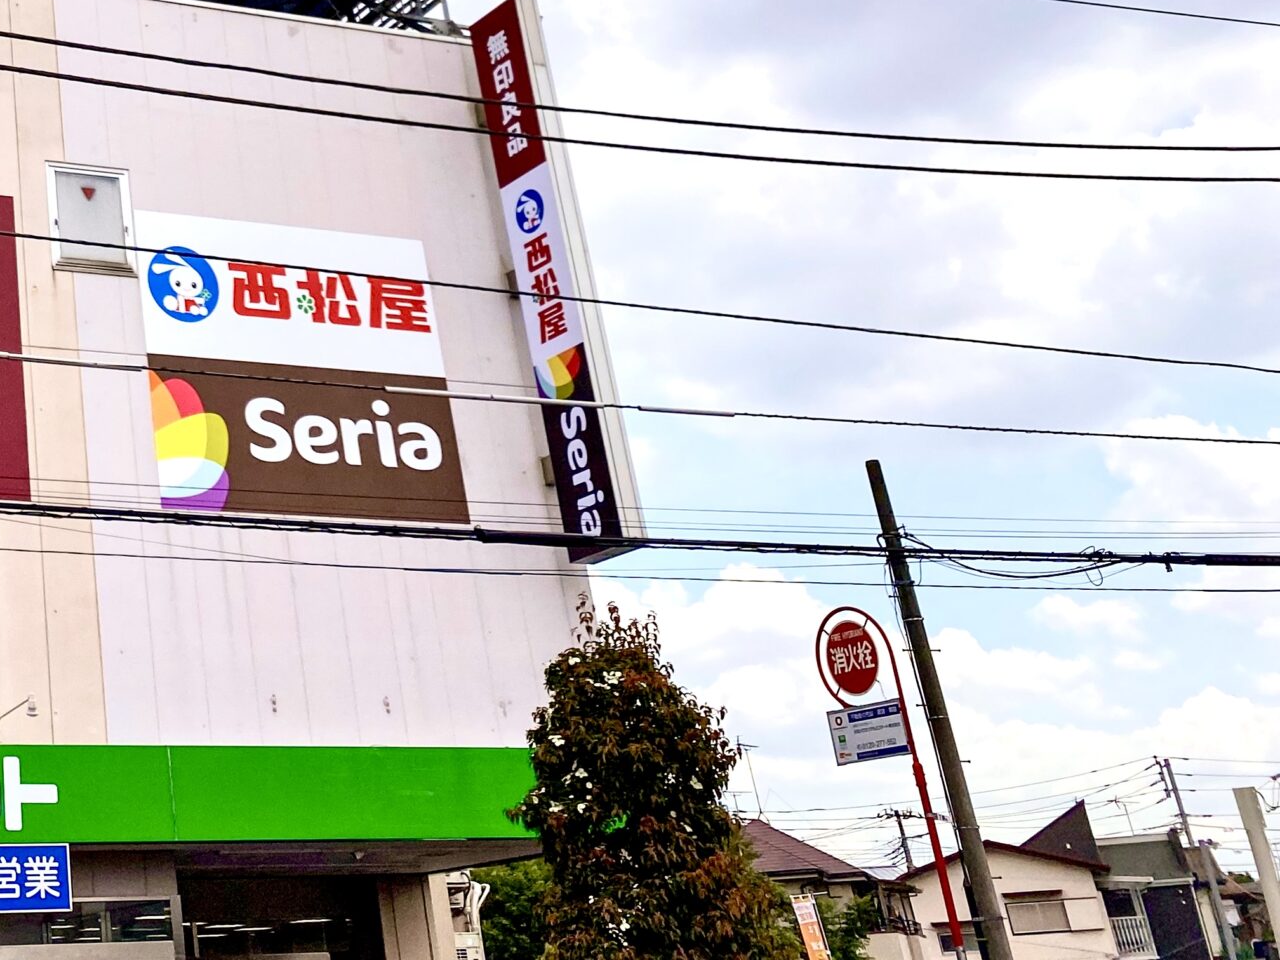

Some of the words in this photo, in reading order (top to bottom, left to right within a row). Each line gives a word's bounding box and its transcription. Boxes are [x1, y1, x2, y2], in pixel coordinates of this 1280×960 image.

[487, 29, 528, 158] 無印良品
[228, 262, 432, 334] 西松屋
[523, 232, 568, 344] 西松屋
[244, 397, 443, 472] Seria
[560, 406, 604, 539] Seria
[830, 640, 876, 675] 消火栓
